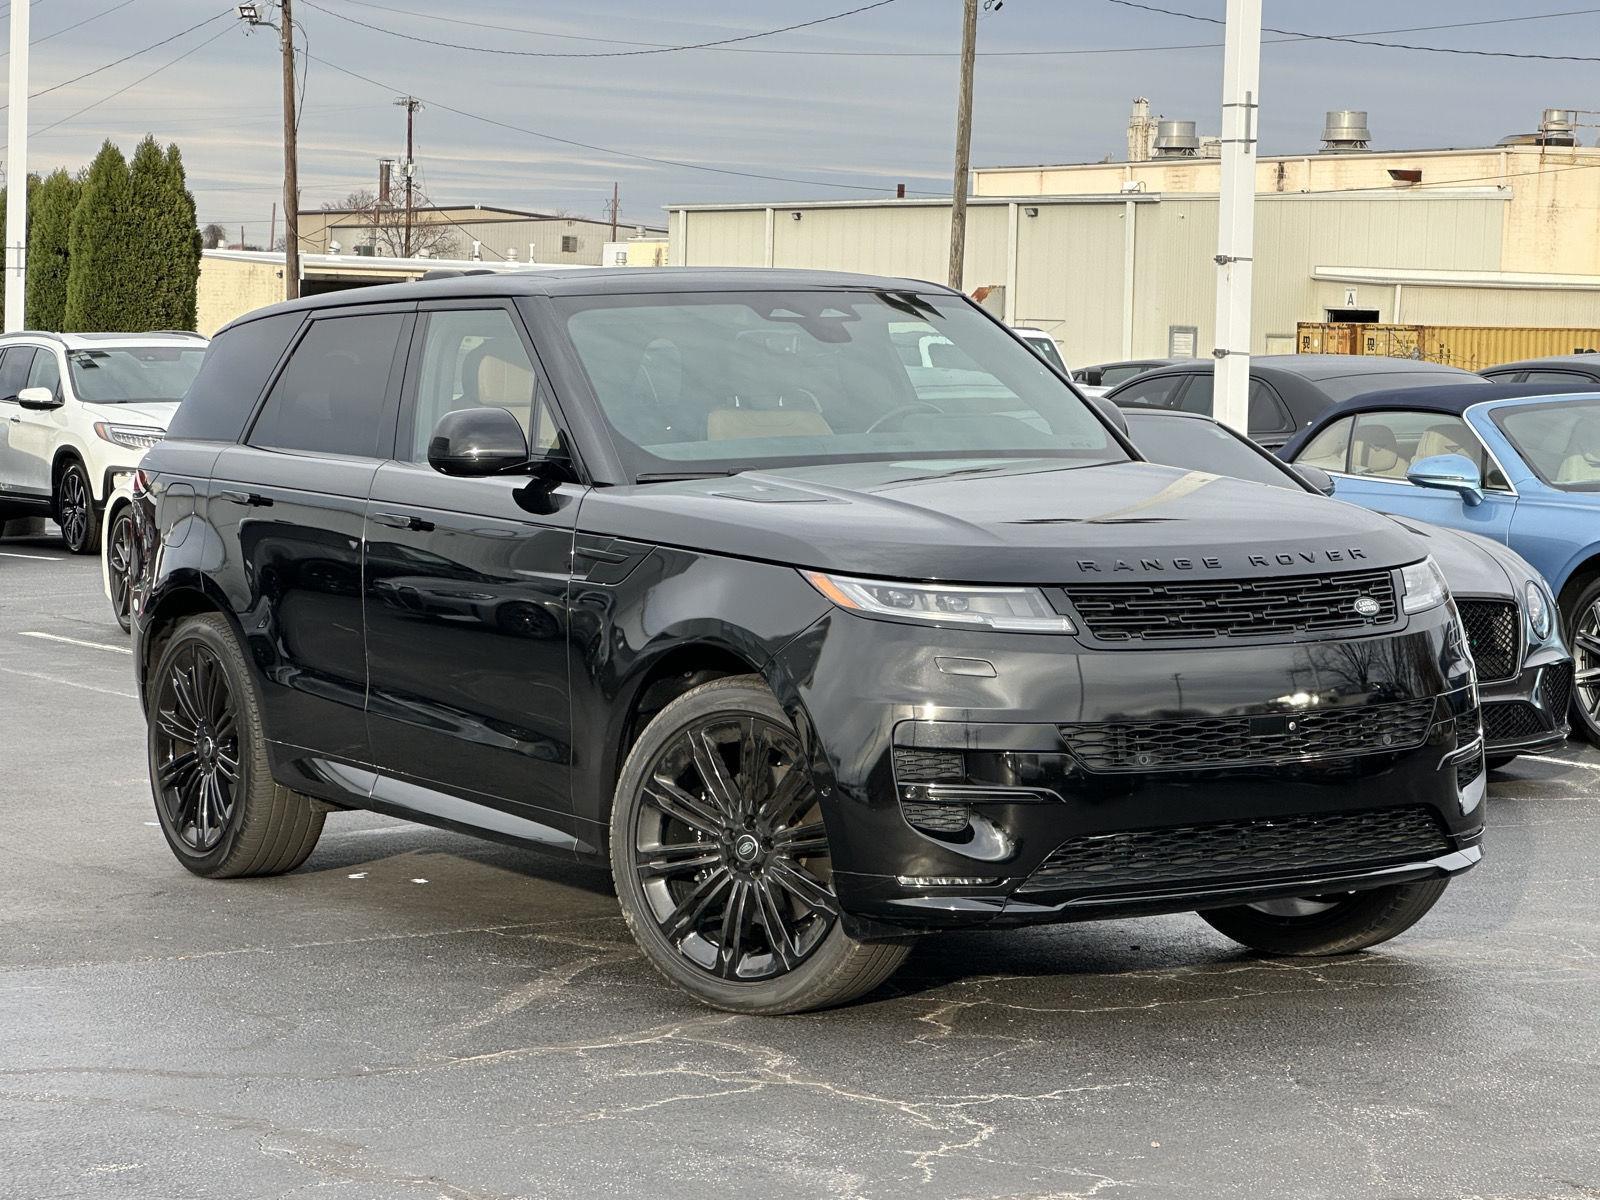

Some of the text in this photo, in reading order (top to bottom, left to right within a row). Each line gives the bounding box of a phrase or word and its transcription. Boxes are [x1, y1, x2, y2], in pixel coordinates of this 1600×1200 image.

[1347, 292, 1355, 305] A
[1076, 548, 1368, 573] RANGE ROVER
